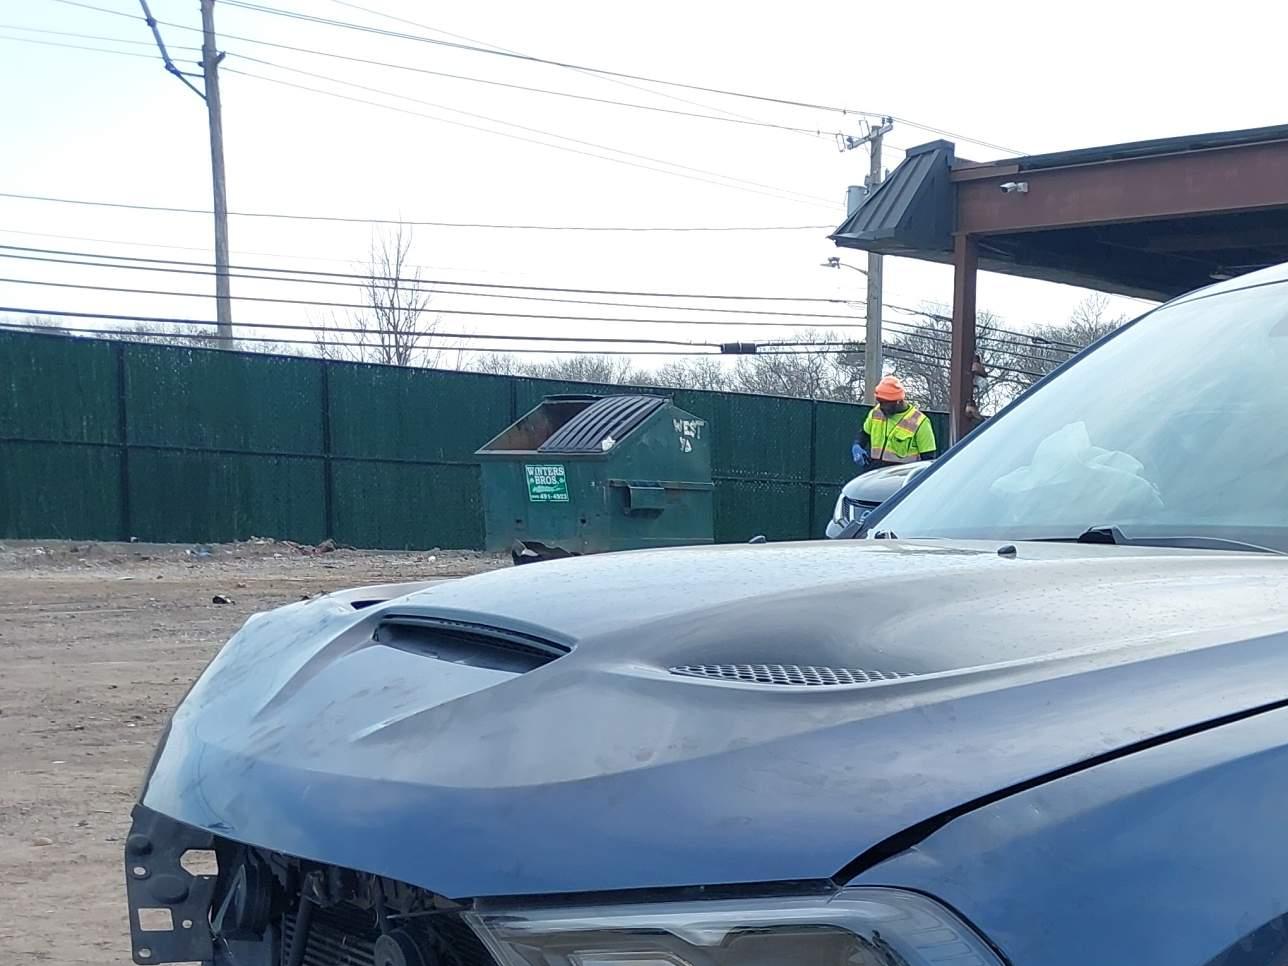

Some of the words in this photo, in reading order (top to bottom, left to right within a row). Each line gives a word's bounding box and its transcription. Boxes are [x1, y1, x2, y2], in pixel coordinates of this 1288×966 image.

[672, 418, 705, 440] WEST
[526, 467, 565, 476] WINTERS
[534, 475, 560, 485] BROS.
